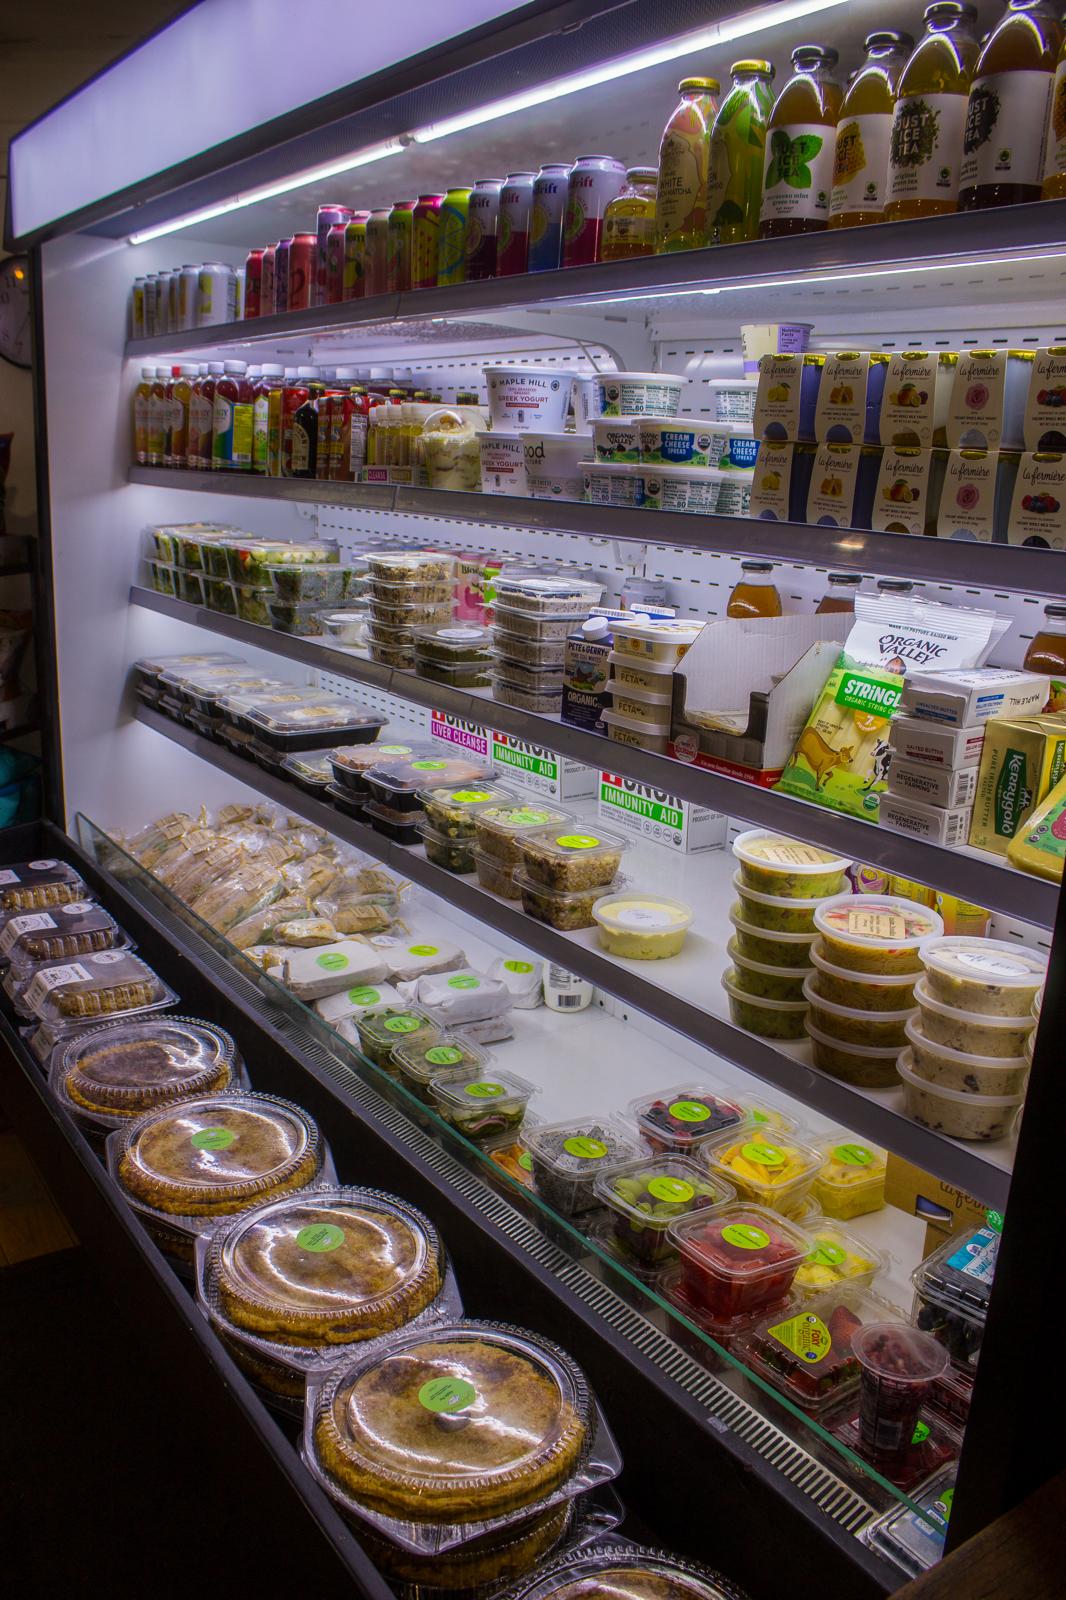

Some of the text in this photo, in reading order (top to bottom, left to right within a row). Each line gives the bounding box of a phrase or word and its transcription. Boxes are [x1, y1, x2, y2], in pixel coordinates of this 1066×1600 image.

[898, 142, 920, 156] TEA
[528, 379, 548, 389] HILL
[520, 395, 549, 404] YOGURT
[664, 432, 691, 441] CREAM
[501, 442, 522, 454] HILL
[663, 440, 691, 450] CHEESE
[732, 440, 757, 448] CREAM
[732, 447, 757, 457] CHEESE
[496, 460, 524, 468] YOGURT
[879, 634, 948, 659] ORGANIC
[880, 644, 934, 665] VALLEY
[620, 672, 640, 685] FETA
[567, 690, 600, 707] ORGANIC
[618, 701, 637, 714] FETA
[432, 722, 452, 739] LIVER
[452, 729, 486, 754] CLEANSE
[495, 746, 533, 770] IMMUNITY
[539, 759, 554, 777] AID
[895, 773, 939, 790] REGENERATIVE
[604, 786, 655, 818] IMMUNITY
[659, 806, 679, 827] AID
[887, 811, 929, 830] REGENERATIVE
